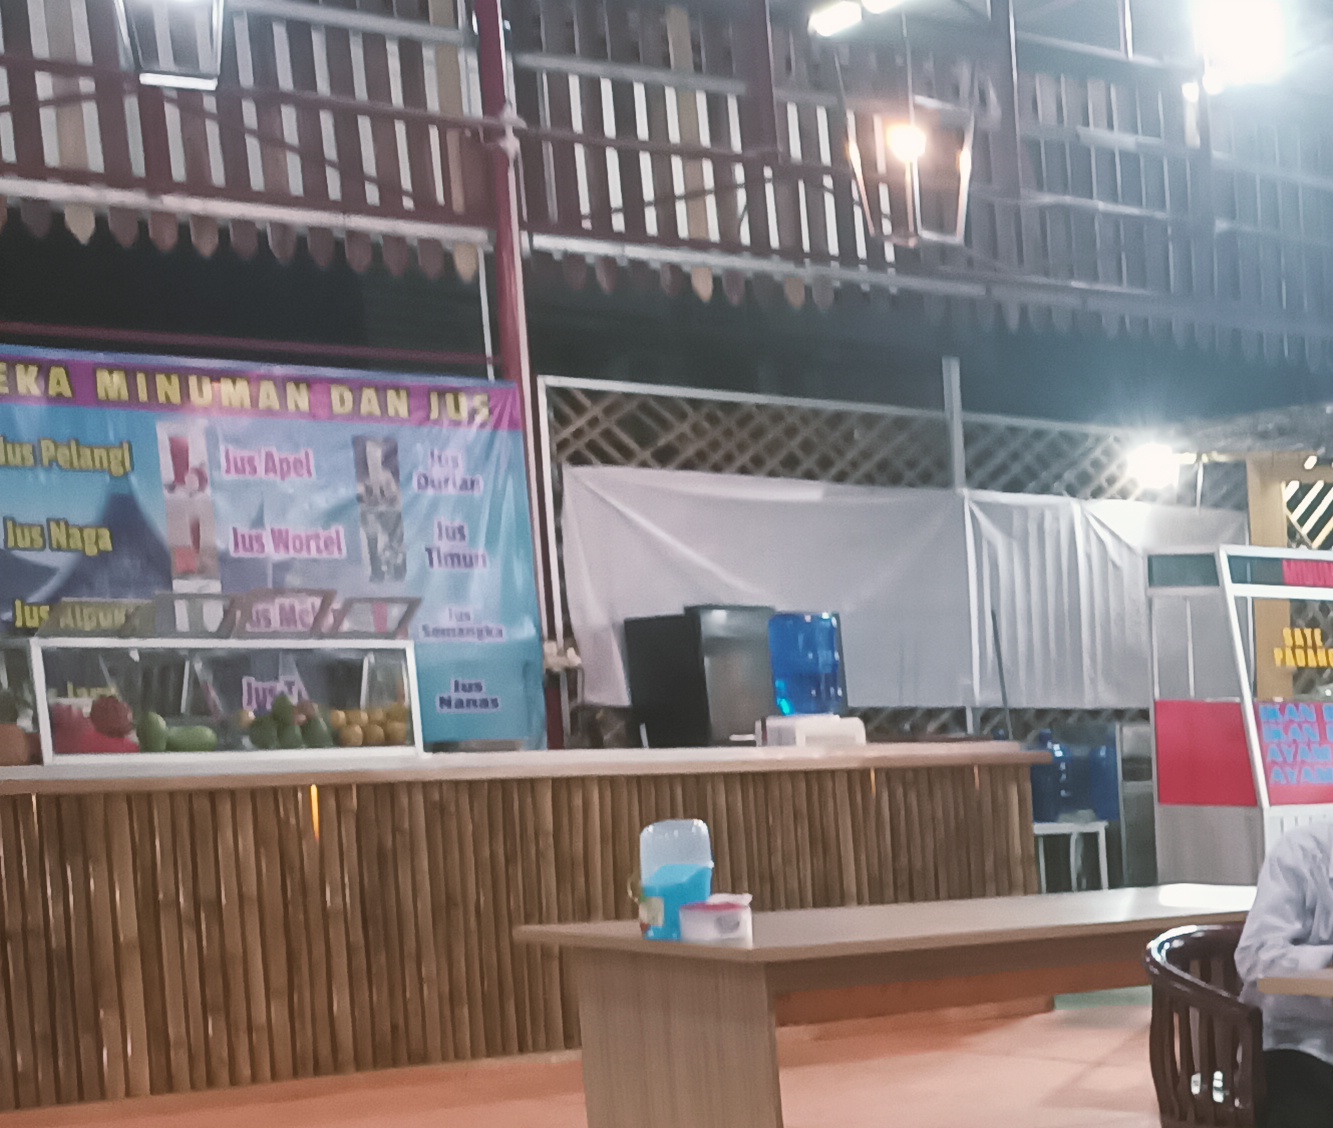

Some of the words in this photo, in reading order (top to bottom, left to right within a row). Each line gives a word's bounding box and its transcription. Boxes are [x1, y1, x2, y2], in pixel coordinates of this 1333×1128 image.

[96, 368, 310, 413] MINUMAN
[330, 383, 410, 420] DAN
[430, 391, 490, 422] JUS
[223, 447, 258, 477] Jus
[263, 449, 314, 482] Apel
[49, 519, 112, 556] Naga
[271, 526, 344, 556] Wortel
[437, 695, 500, 711] Nanas
